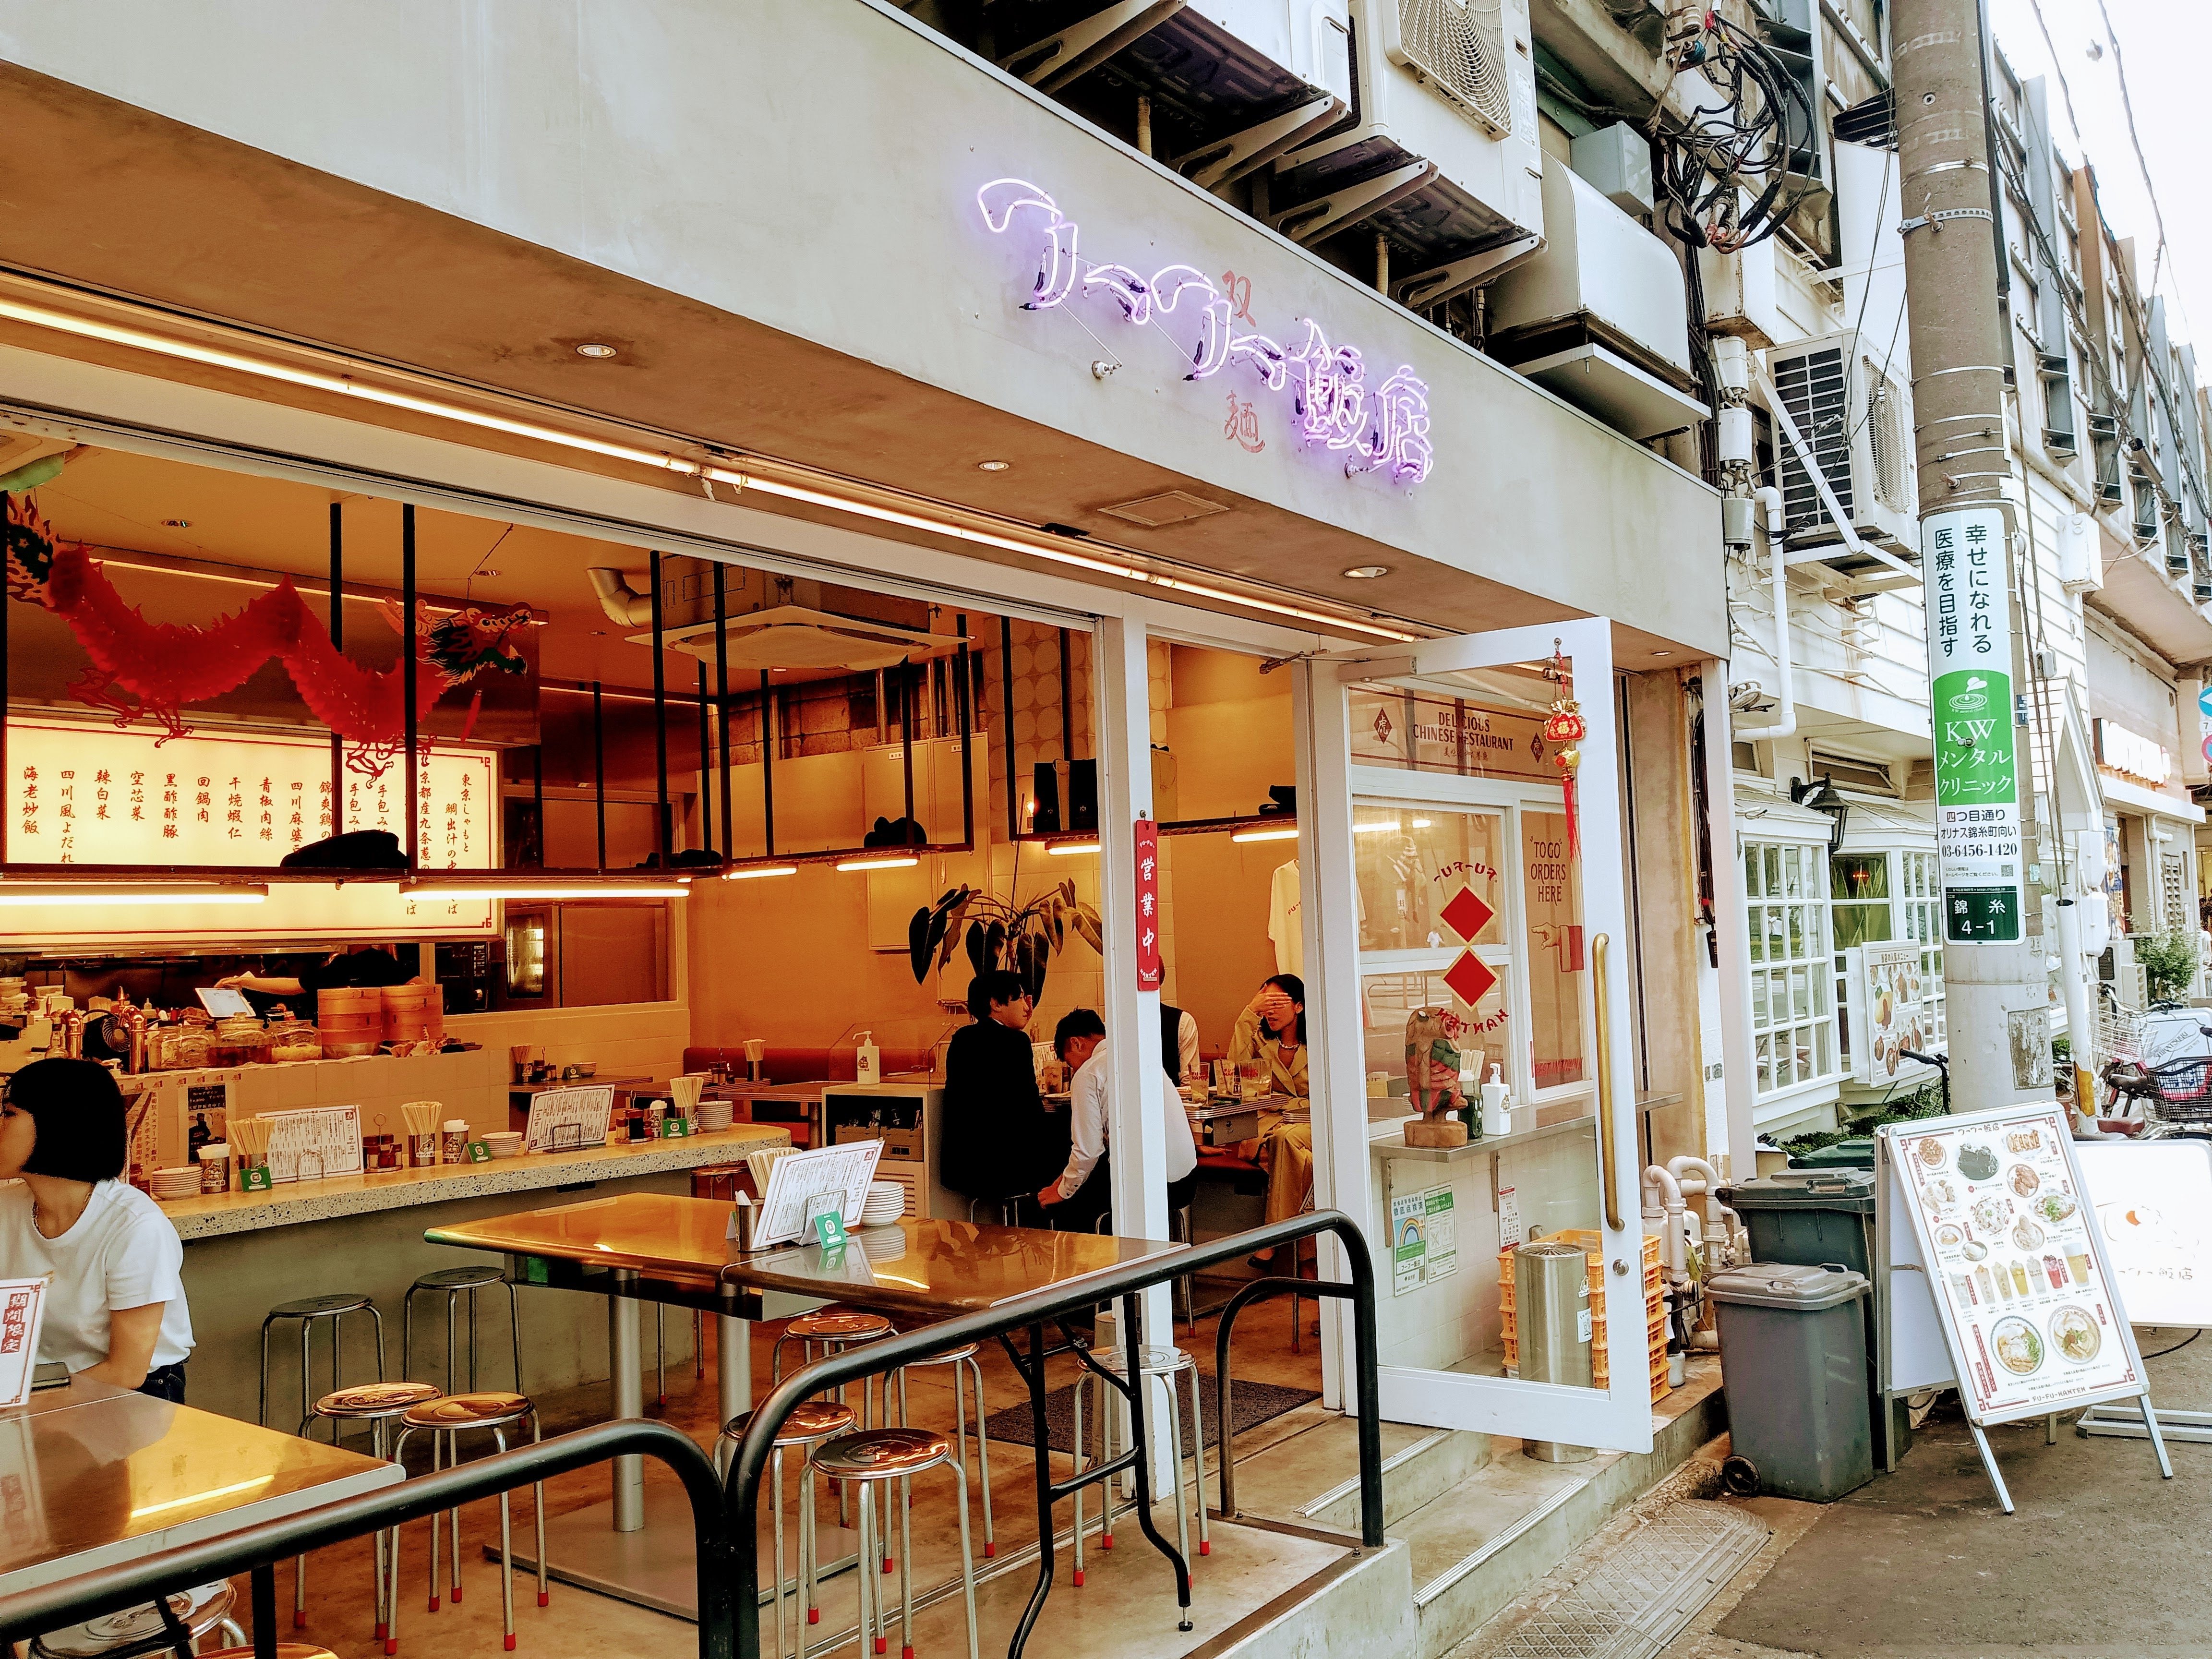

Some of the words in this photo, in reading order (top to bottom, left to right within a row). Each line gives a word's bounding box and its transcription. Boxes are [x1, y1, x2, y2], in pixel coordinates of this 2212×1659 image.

[977, 178, 1433, 482] フーフー飯店
[1935, 528, 1959, 657] 医療を目指す
[1965, 524, 1992, 654] 幸せになれる
[1413, 724, 1455, 743] CHINESE
[1439, 711, 1490, 732] DELCIOUS
[1945, 719, 1997, 742] KW
[1938, 748, 2011, 771] メンタル
[22, 766, 40, 835] 海老炒飯
[95, 769, 112, 820] 辣白菜
[130, 770, 146, 821] 空芯菜
[196, 777, 211, 824] 回鍋肉
[227, 777, 243, 840] 干焼蝦仁
[258, 777, 273, 842] 青椒肉絲
[349, 783, 361, 833] 手包み
[377, 784, 389, 833] 手包み
[1939, 775, 2011, 796] クリニック
[60, 769, 76, 863] 四川風よだれ
[461, 773, 472, 853] 東京しゃもと
[1941, 825, 2016, 839] オリナス錦糸町向い
[1947, 809, 2005, 822] 四つ目通り
[1530, 863, 1566, 884] ORDERS
[1942, 843, 2017, 858] 03-6456-1420
[1140, 855, 1155, 957] 営業中
[1538, 886, 1562, 906] HERE
[1954, 899, 2006, 914] 錦糸
[1961, 920, 1995, 935] 4-1
[1, 1294, 28, 1353] 期間限定
